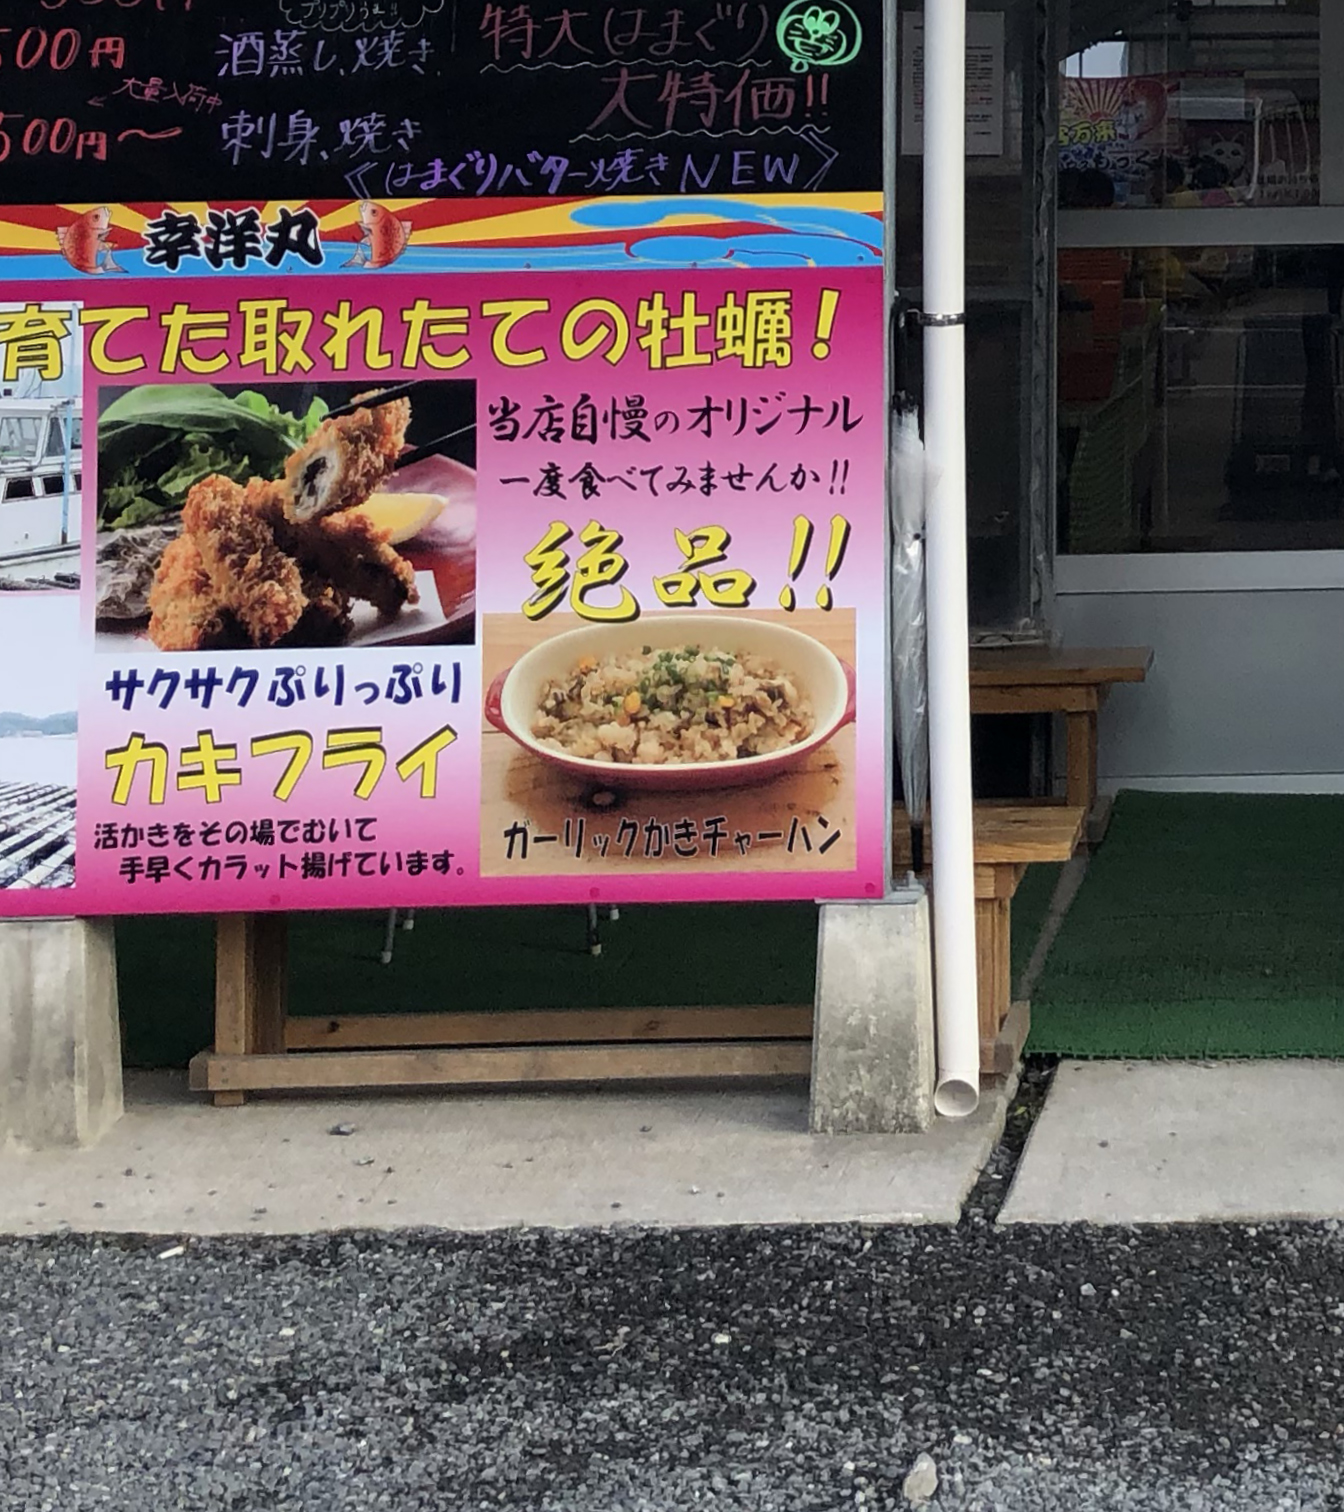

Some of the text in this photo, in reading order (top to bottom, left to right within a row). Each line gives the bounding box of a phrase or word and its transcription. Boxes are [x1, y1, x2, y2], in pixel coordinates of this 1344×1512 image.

[141, 206, 328, 271] 幸洋丸
[485, 392, 864, 447] 当店自慢のオリジナル
[103, 724, 459, 807] カキフライ
[93, 817, 378, 851] 活かきをその場でむいて
[503, 815, 844, 862] ガーリックかきチャーハン
[118, 849, 467, 885] 手早くカラット揚げています。
